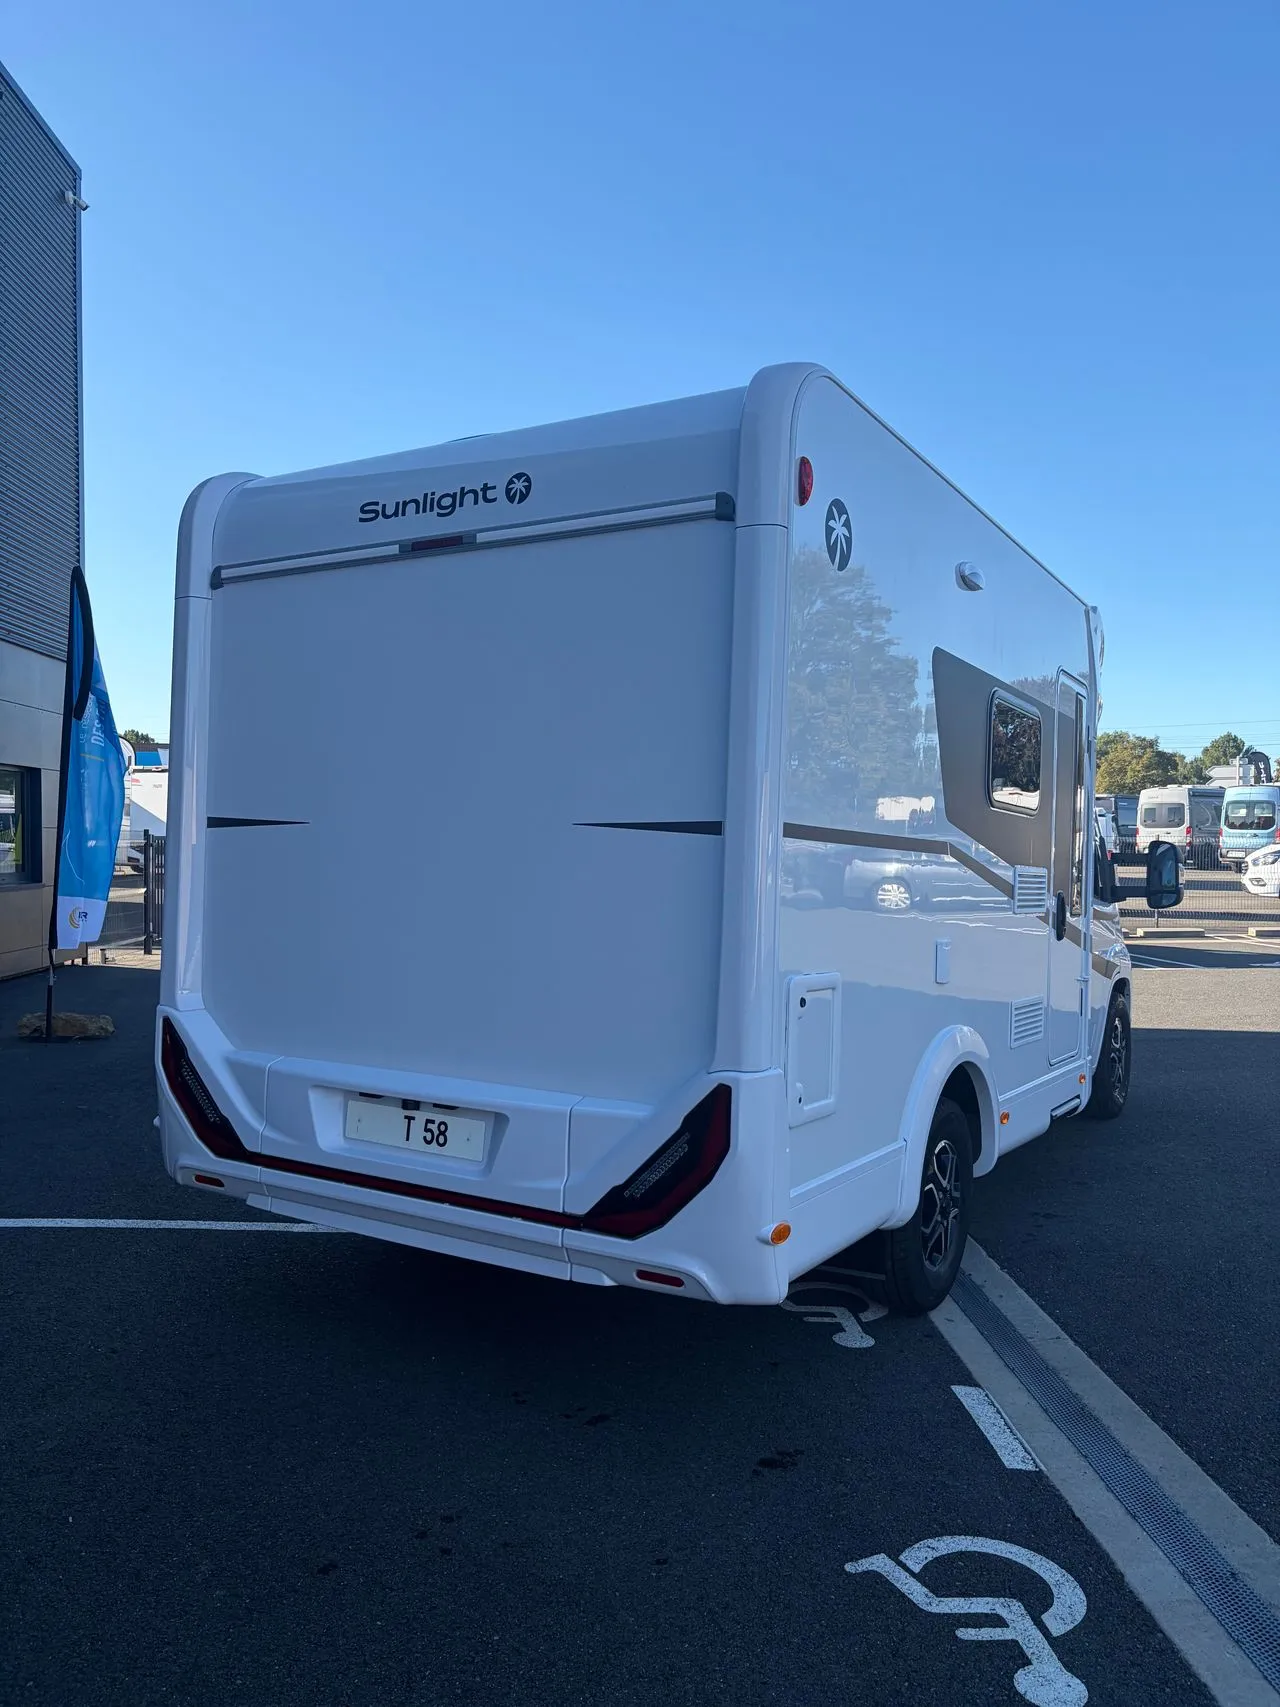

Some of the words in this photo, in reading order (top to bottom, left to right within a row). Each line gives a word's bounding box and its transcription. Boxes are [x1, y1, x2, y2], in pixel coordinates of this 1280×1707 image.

[358, 482, 498, 523] Sunlight
[403, 1115, 416, 1142] T
[422, 1118, 449, 1148] 58
